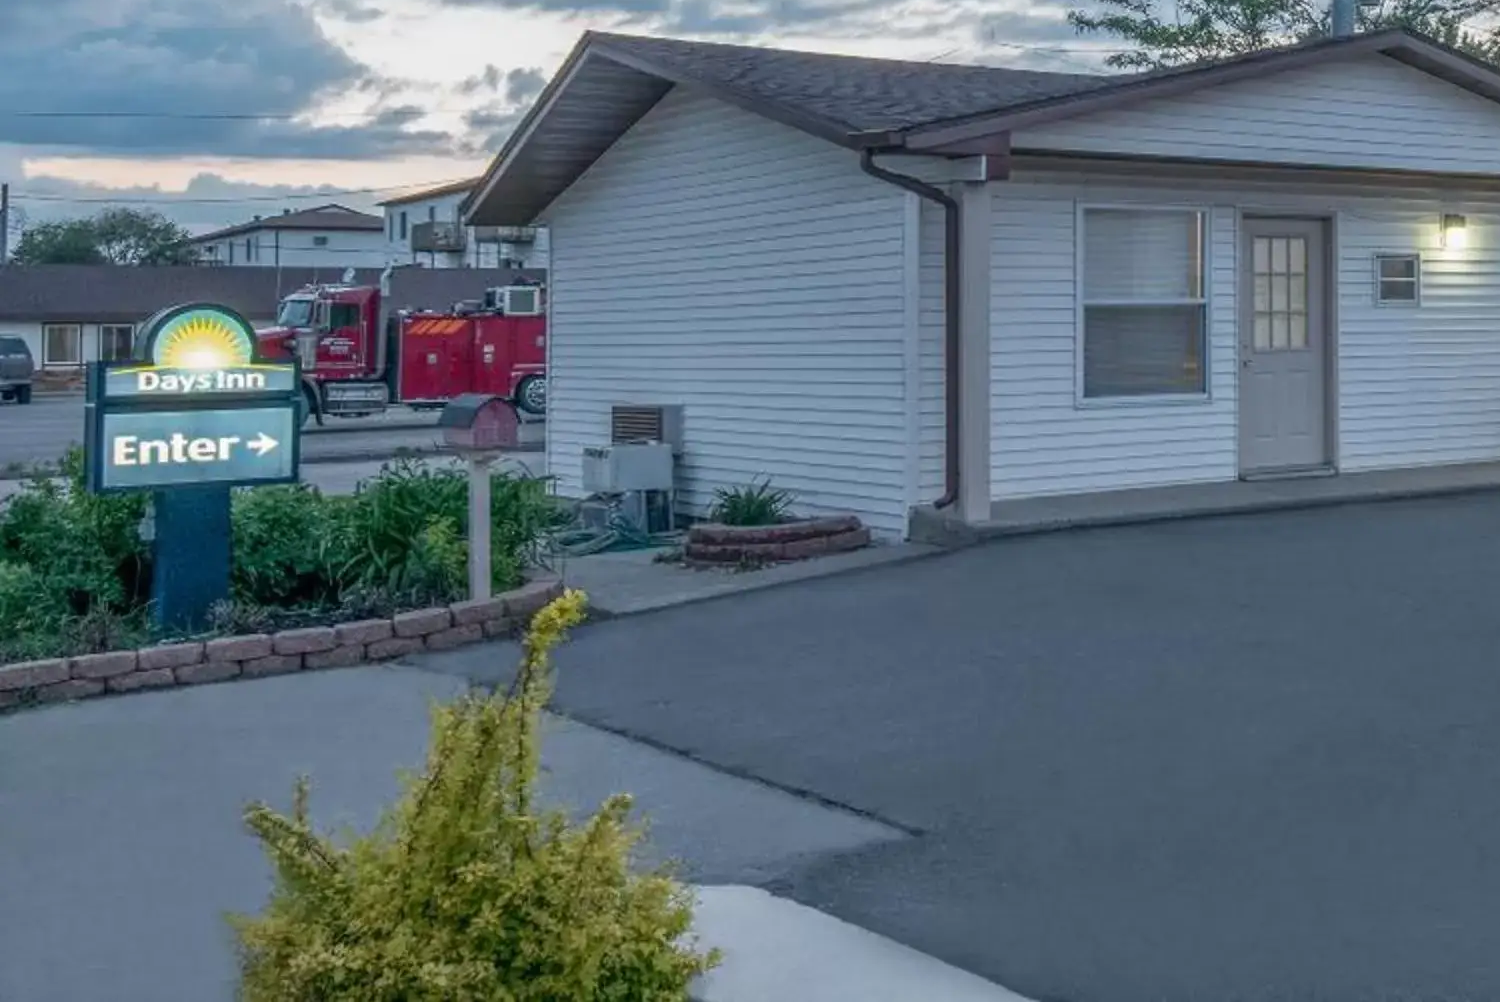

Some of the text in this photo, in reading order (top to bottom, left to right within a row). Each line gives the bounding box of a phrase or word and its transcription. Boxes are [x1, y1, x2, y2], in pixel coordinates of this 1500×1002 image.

[138, 371, 265, 392] Days Inn
[113, 433, 240, 466] Enter
